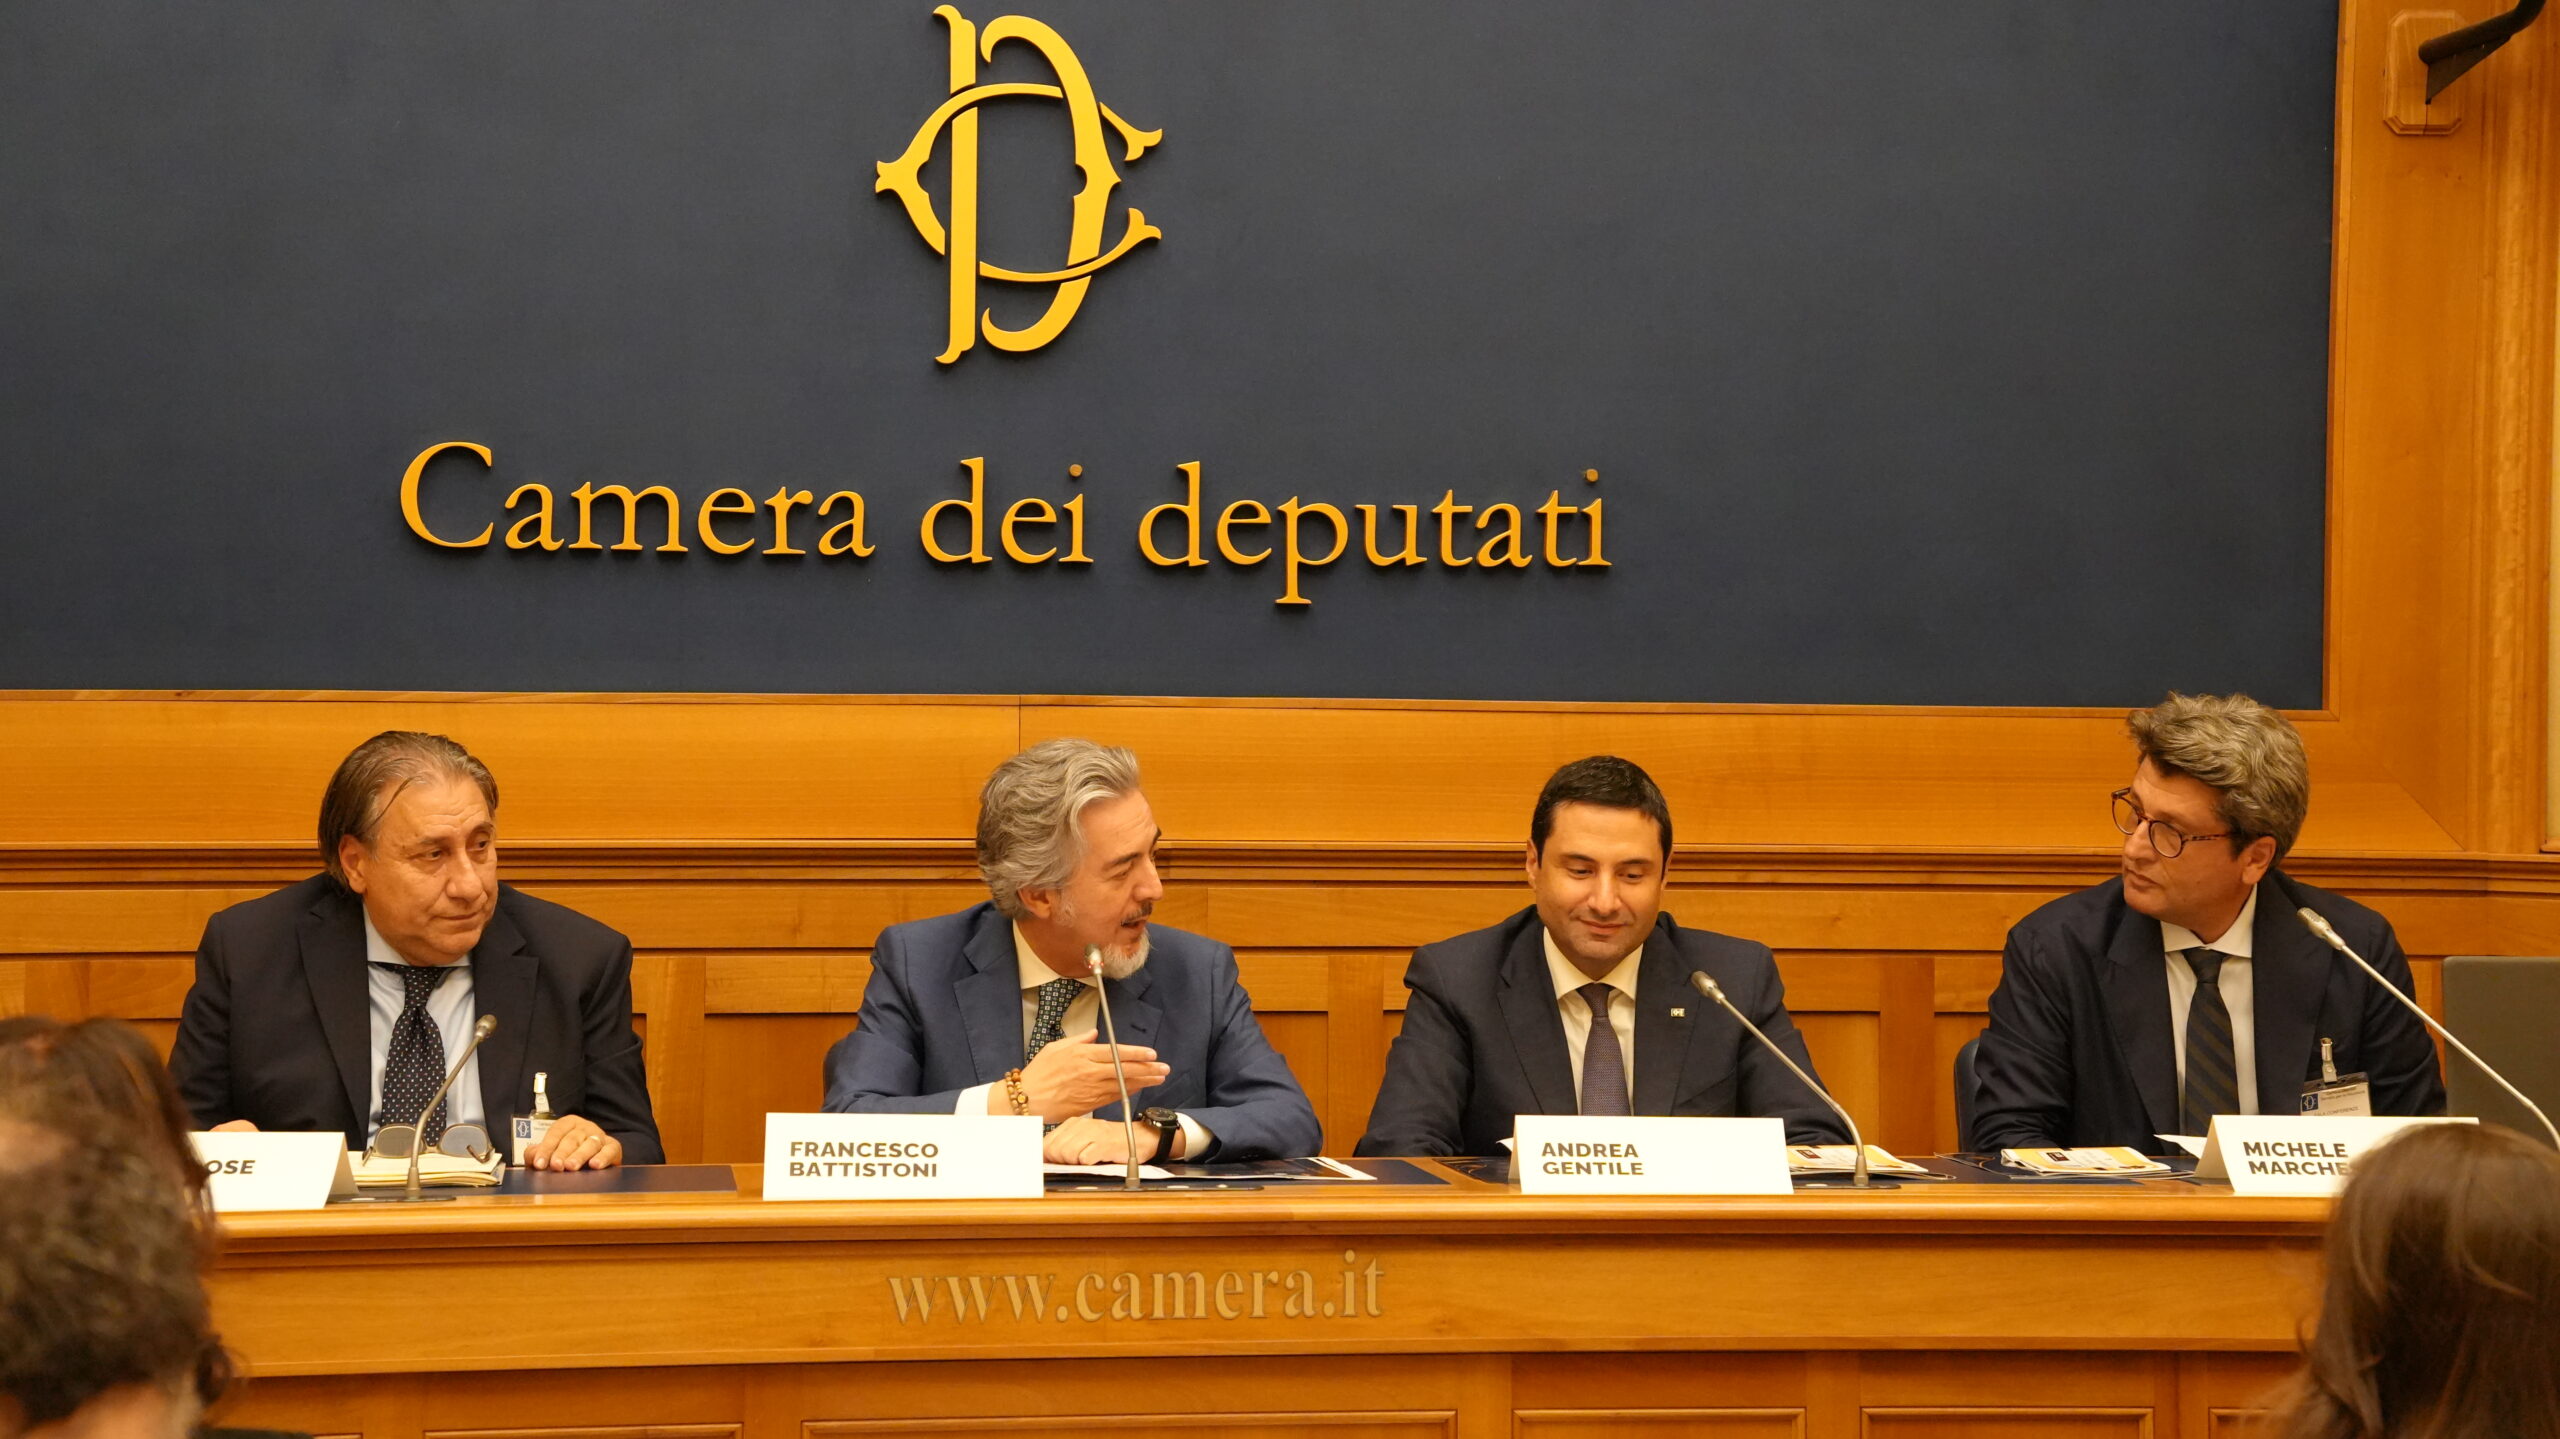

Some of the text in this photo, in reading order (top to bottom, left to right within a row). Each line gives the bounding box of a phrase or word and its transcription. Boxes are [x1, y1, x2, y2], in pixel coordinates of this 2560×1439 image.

[400, 441, 1612, 604] Camera dei deputati
[790, 1141, 939, 1158] FRANCESCO
[1541, 1142, 1639, 1158] ANDREA
[2243, 1141, 2348, 1158] MICHELE
[789, 1161, 937, 1178] BATTISTONI
[1542, 1161, 1644, 1176] GENTILE
[887, 1248, 1385, 1324] www.camera.it
